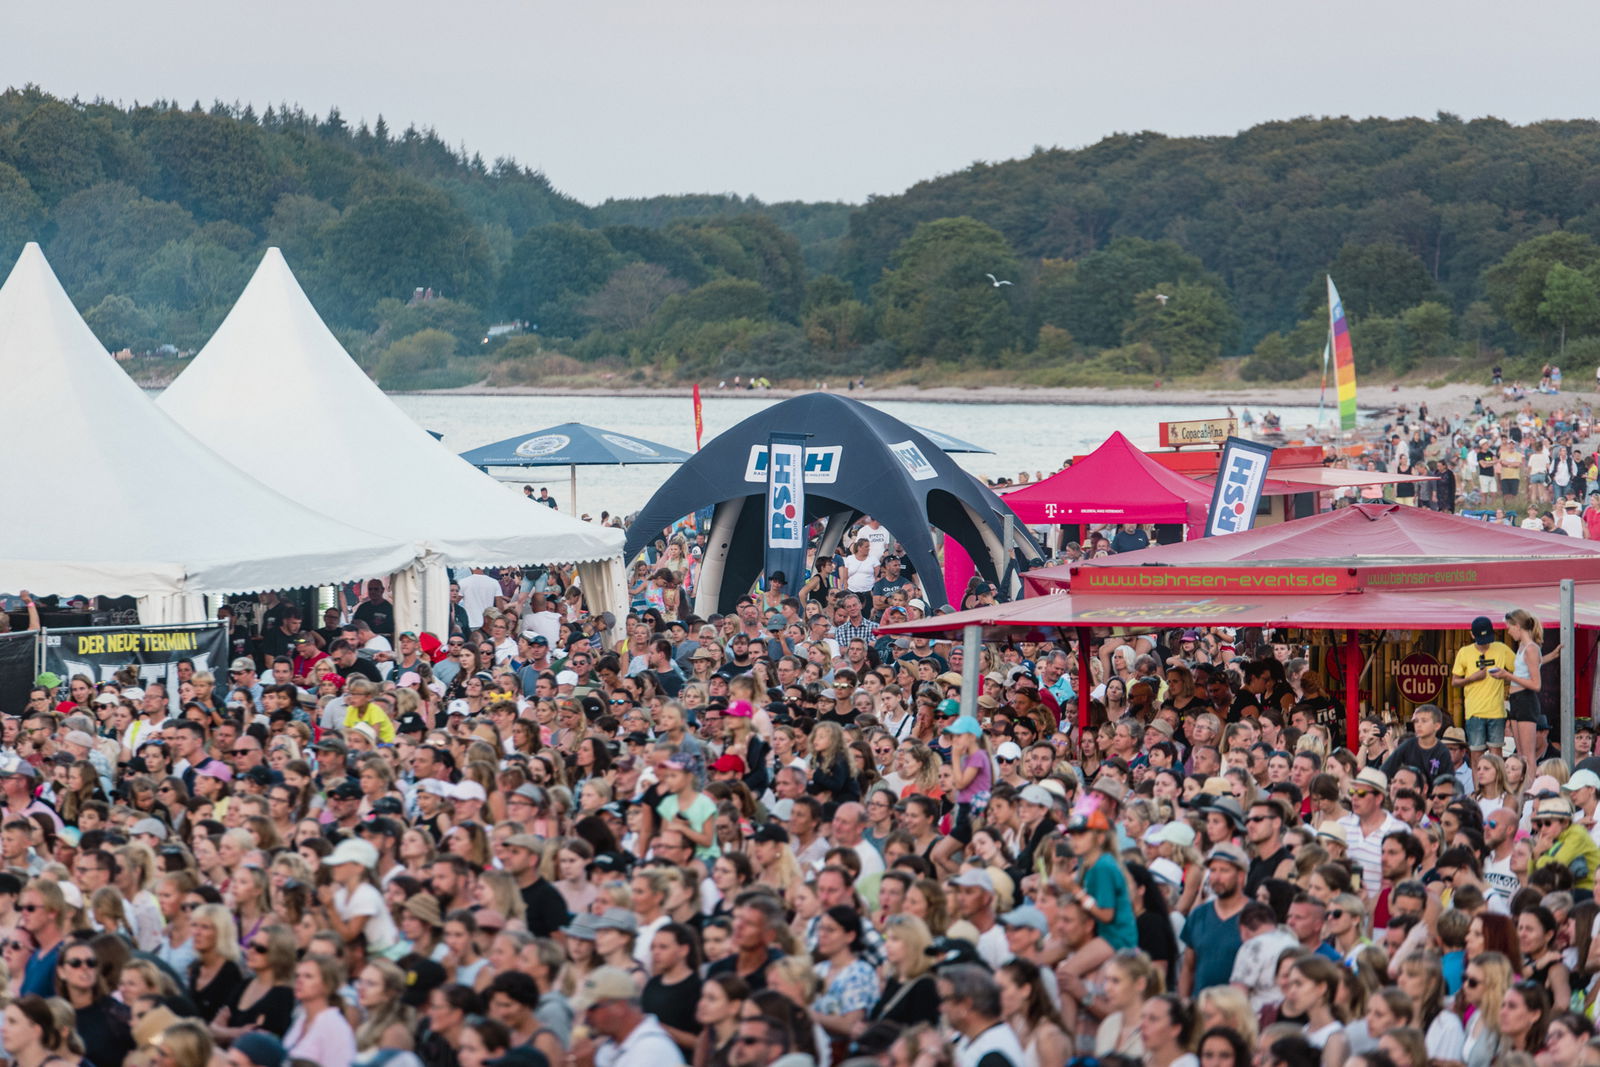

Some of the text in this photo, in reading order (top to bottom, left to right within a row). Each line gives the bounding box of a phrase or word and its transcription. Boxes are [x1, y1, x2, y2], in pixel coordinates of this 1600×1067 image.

[1089, 572, 1337, 587] www.bahnsen-events.de
[1367, 569, 1477, 585] www.bahnsen-events.de
[77, 635, 105, 656] DER
[106, 633, 140, 653] NEUE
[1391, 660, 1449, 676] Havana
[1402, 678, 1436, 694] Club
